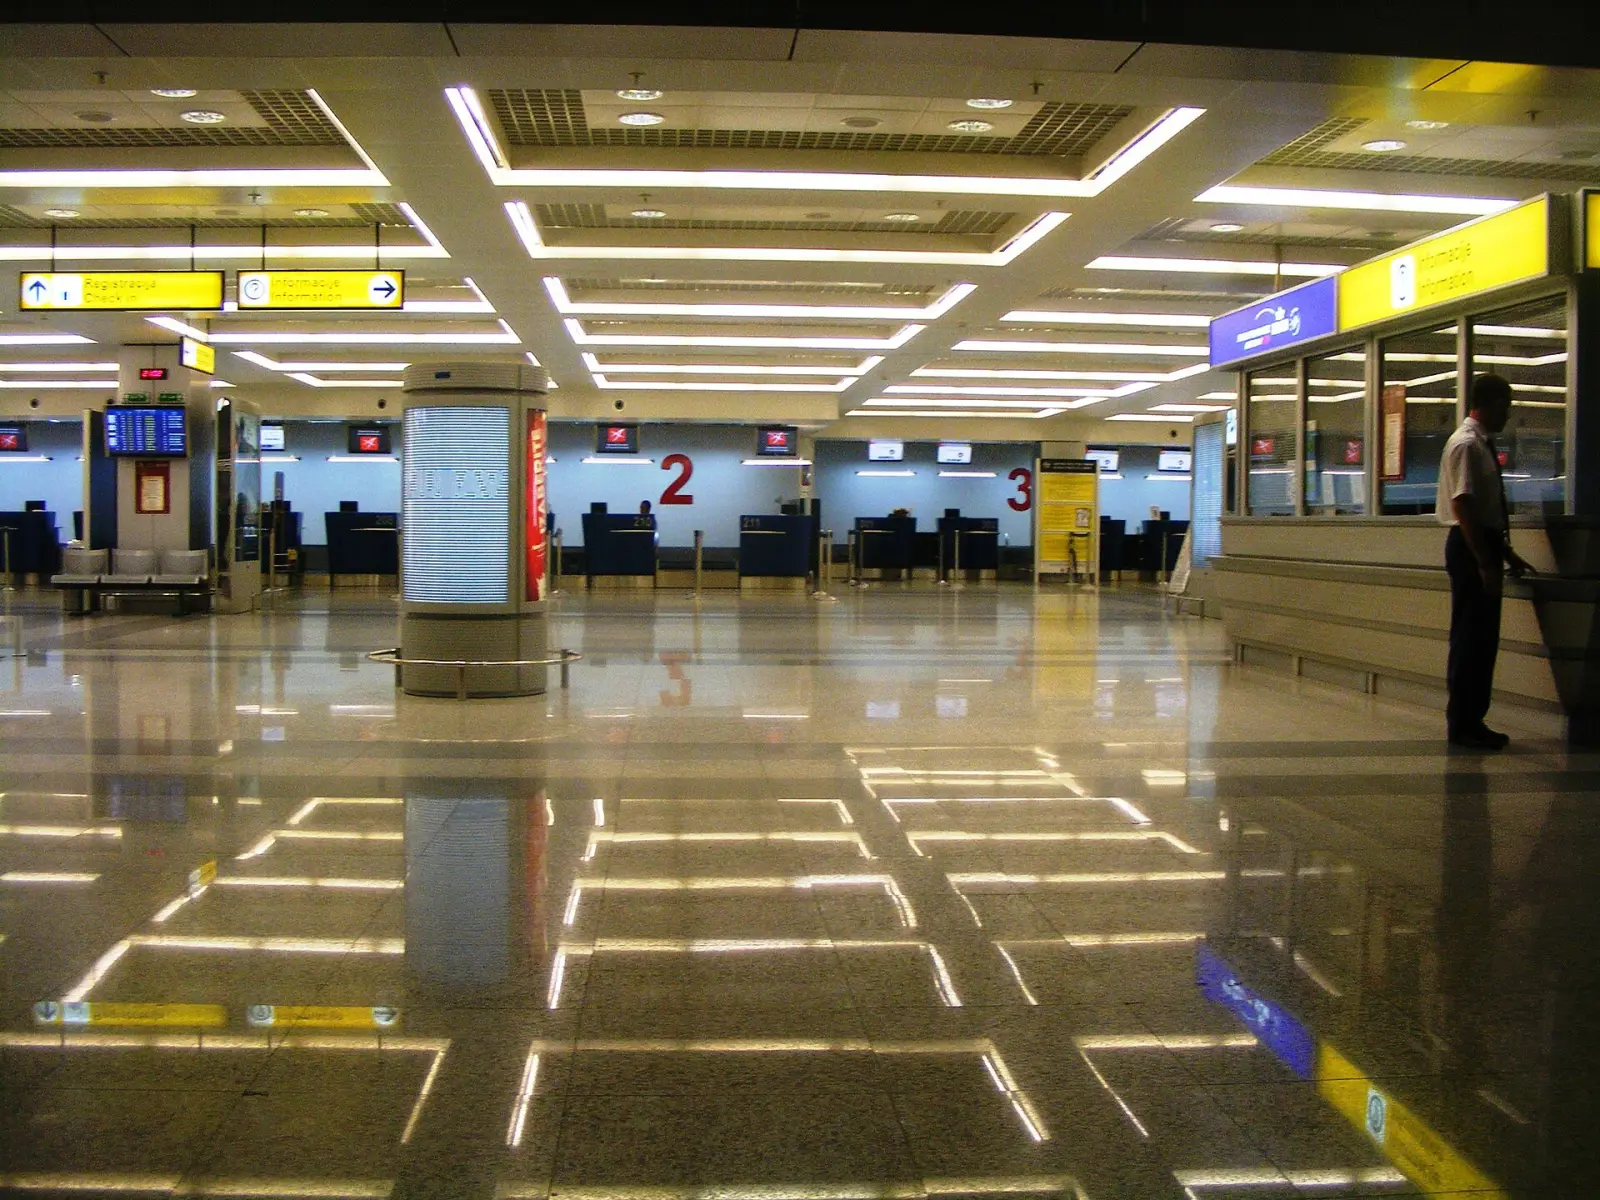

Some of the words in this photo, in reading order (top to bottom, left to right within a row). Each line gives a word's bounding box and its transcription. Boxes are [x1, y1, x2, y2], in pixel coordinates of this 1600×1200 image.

[271, 291, 343, 302] Information
[659, 453, 693, 505] 2
[1007, 467, 1032, 512] 3
